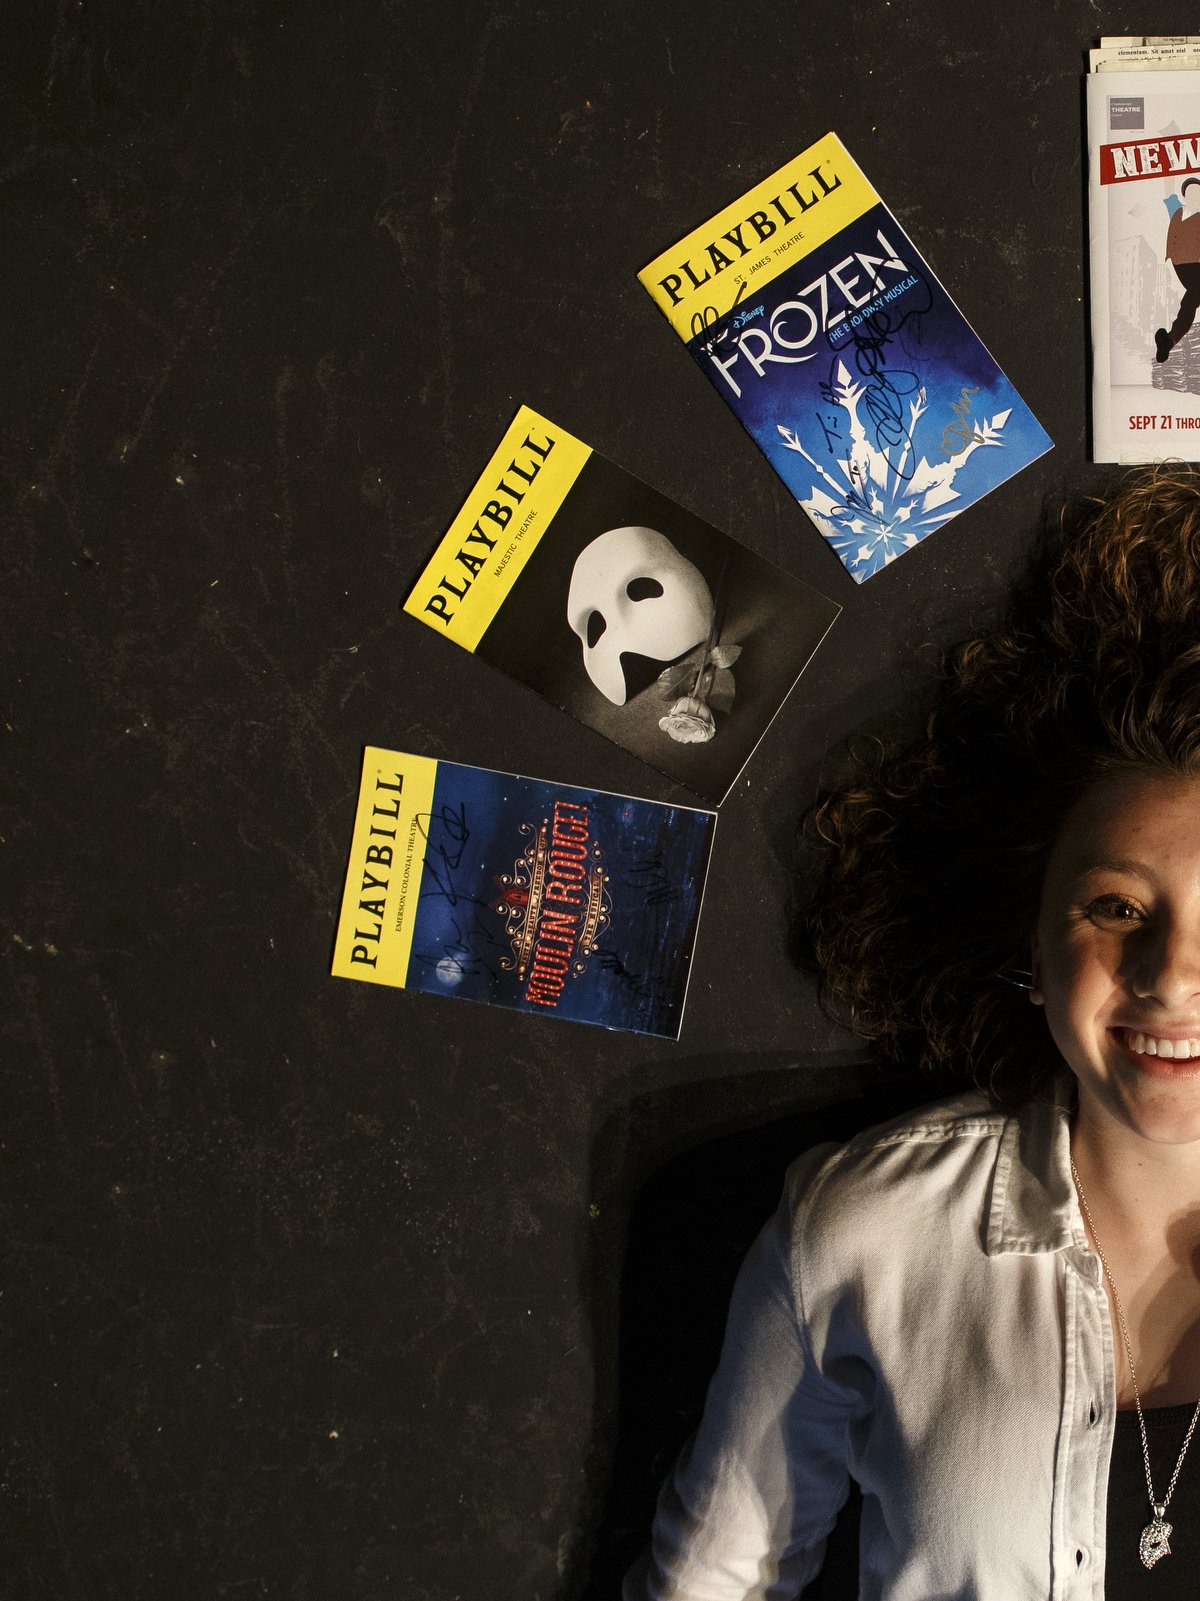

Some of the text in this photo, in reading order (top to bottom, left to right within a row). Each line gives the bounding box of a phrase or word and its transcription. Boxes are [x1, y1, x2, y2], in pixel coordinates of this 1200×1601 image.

[657, 165, 842, 307] PLAYBILL
[733, 231, 805, 285] ST. JAMES THEATRE
[700, 229, 909, 399] FROZEN
[828, 328, 845, 344] THE
[883, 275, 919, 302] MUSICAL
[1129, 415, 1157, 430] SEPT
[1160, 415, 1172, 430] 21
[424, 432, 555, 626] PLAYBILL
[493, 509, 538, 578] MAJESTIC THEATRE
[350, 772, 404, 969] PLAYBILL
[395, 895, 406, 932] EMERSON
[401, 853, 412, 894] COLONIAL
[525, 801, 589, 1007] MOULIN ROUGE!
[527, 905, 537, 935] BEAUTY
[533, 860, 544, 896] FREEDOM
[584, 882, 600, 940] THE MUSICAL
